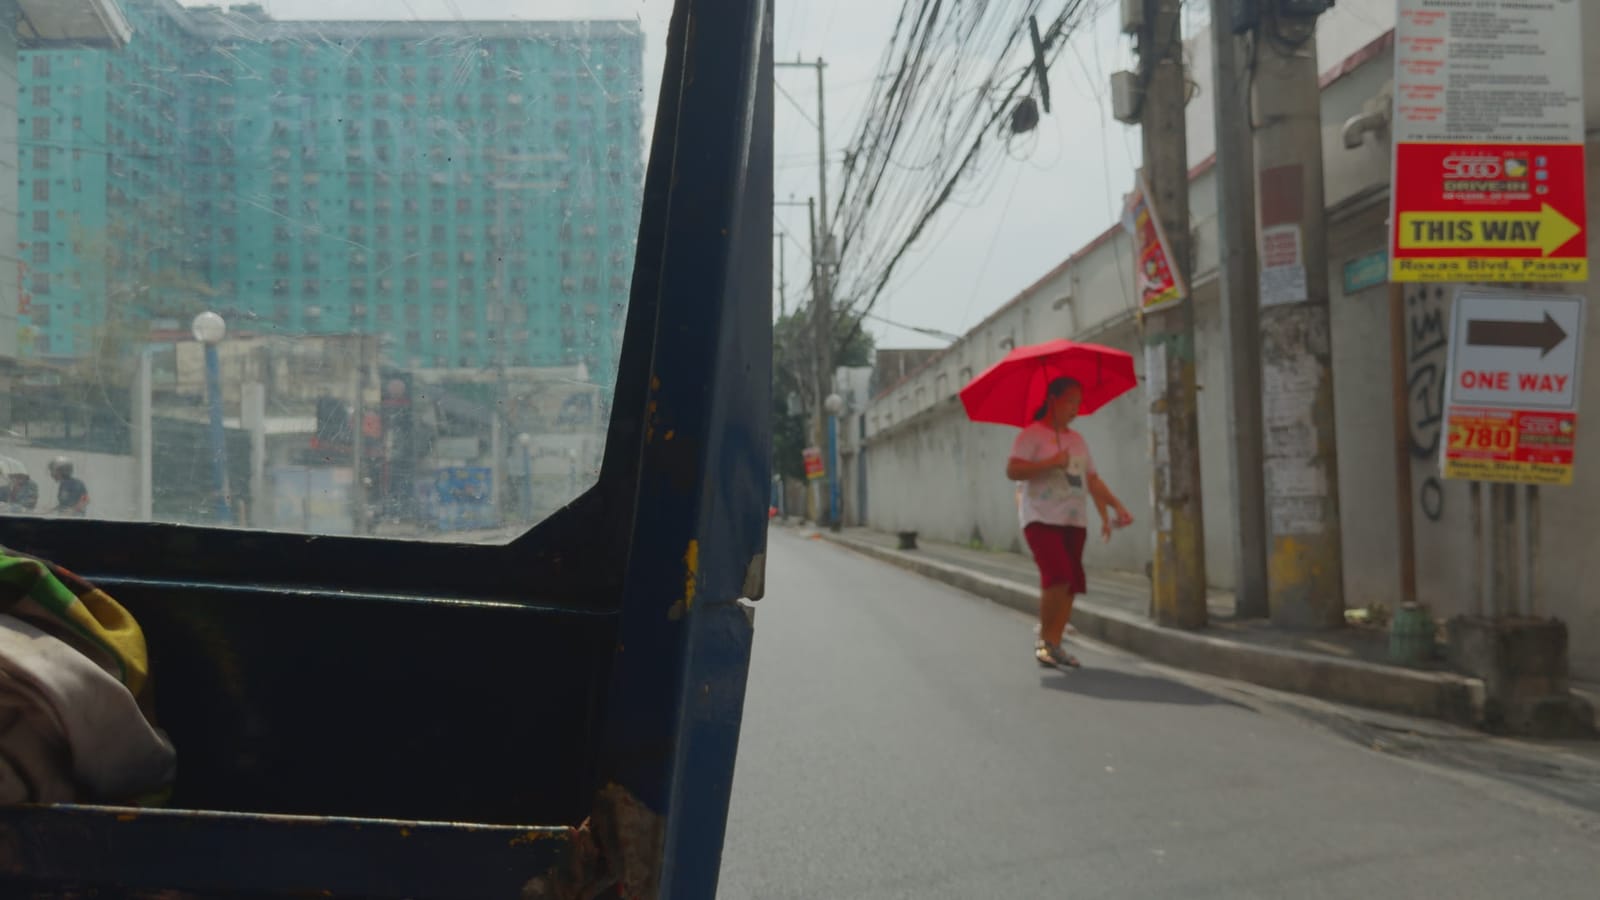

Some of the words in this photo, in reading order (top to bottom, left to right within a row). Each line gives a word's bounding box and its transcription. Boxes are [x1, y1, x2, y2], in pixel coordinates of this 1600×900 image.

[1410, 219, 1473, 242] THIS
[1480, 219, 1541, 242] WAY
[1400, 259, 1460, 271] Roxas
[1522, 259, 1582, 273] Pasay
[1460, 370, 1510, 391] ONE
[1517, 373, 1569, 394] WAY
